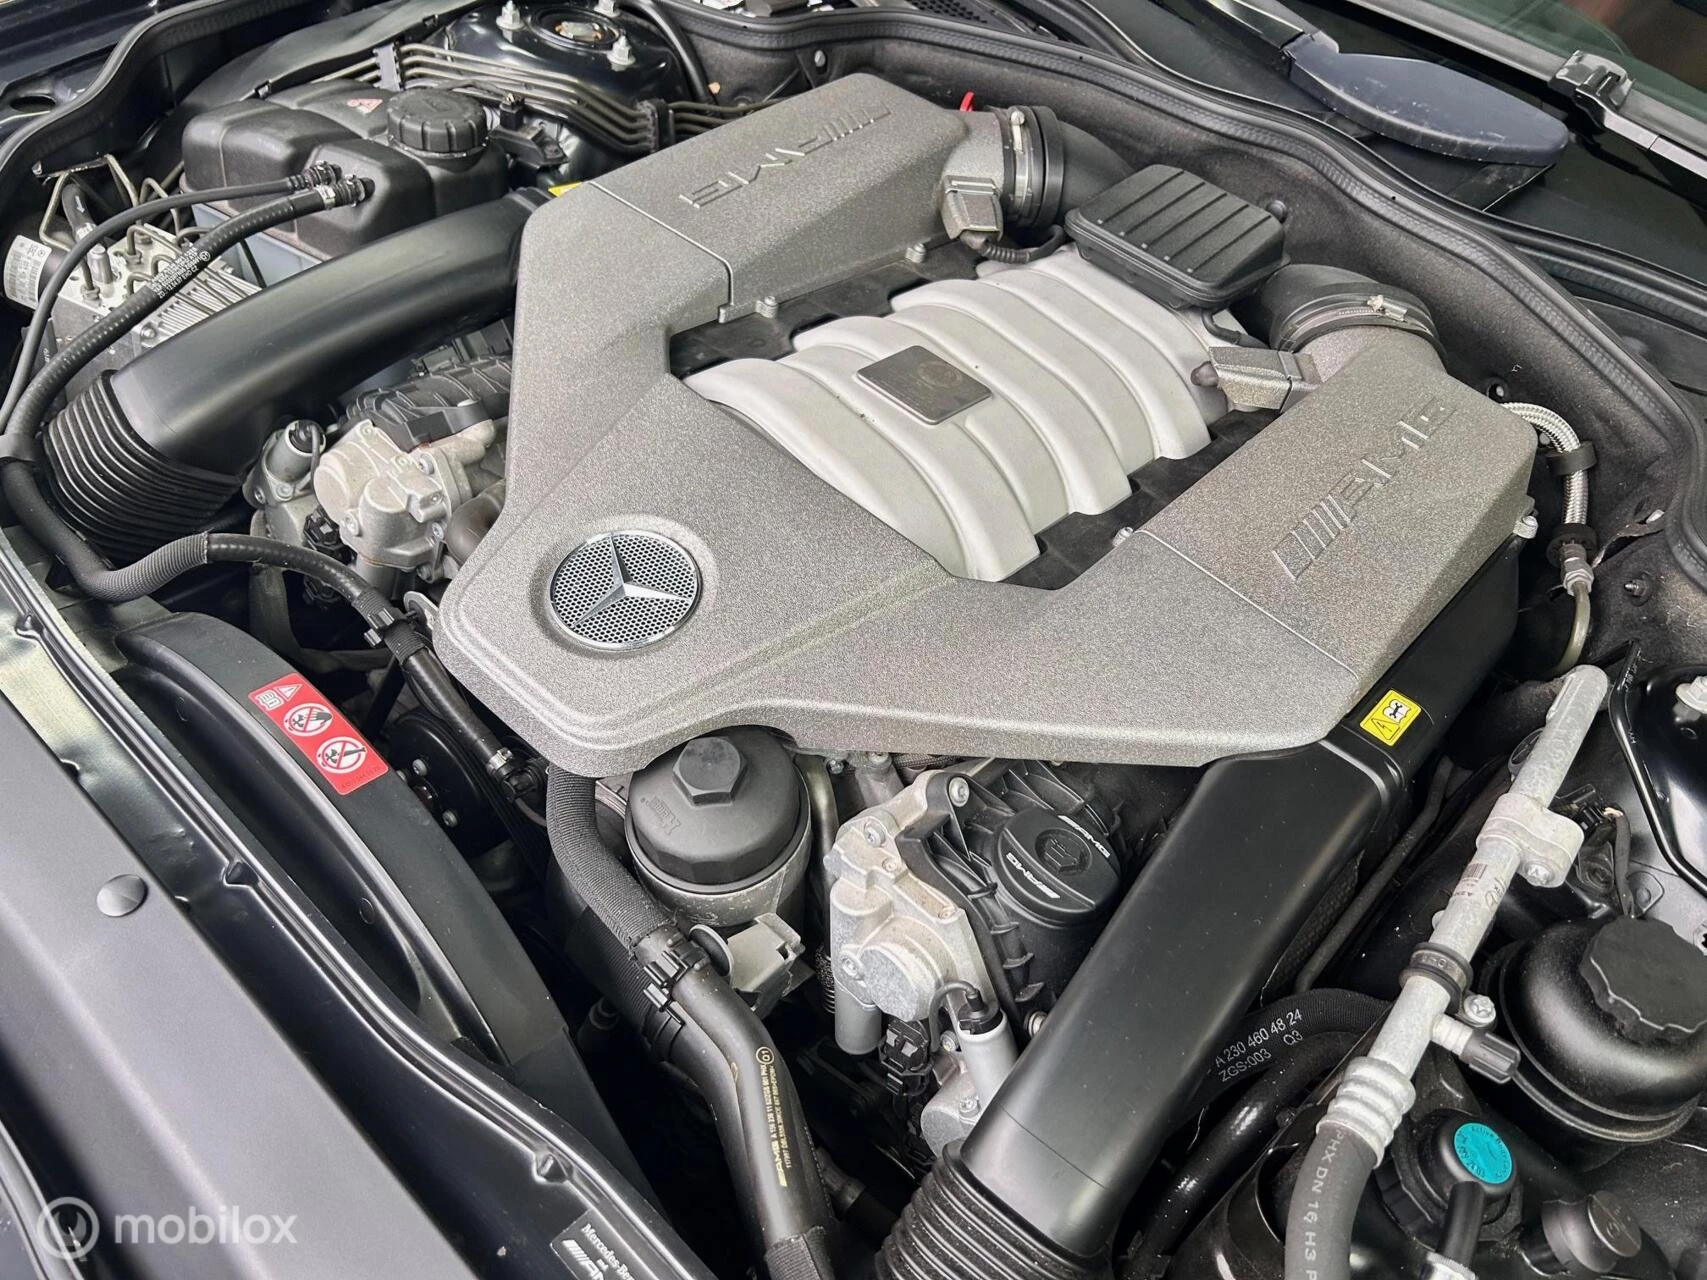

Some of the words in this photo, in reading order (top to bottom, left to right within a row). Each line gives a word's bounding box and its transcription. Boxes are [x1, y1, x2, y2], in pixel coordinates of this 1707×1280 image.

[1213, 1053, 1227, 1069] A
[1222, 1040, 1247, 1063] 230
[1244, 1026, 1270, 1050] 460
[1267, 1016, 1287, 1037] 48
[1285, 1007, 1304, 1027] 24
[1220, 1047, 1271, 1083] ZGS:003
[1312, 1166, 1328, 1194] DN
[1305, 1231, 1317, 1261] H3
